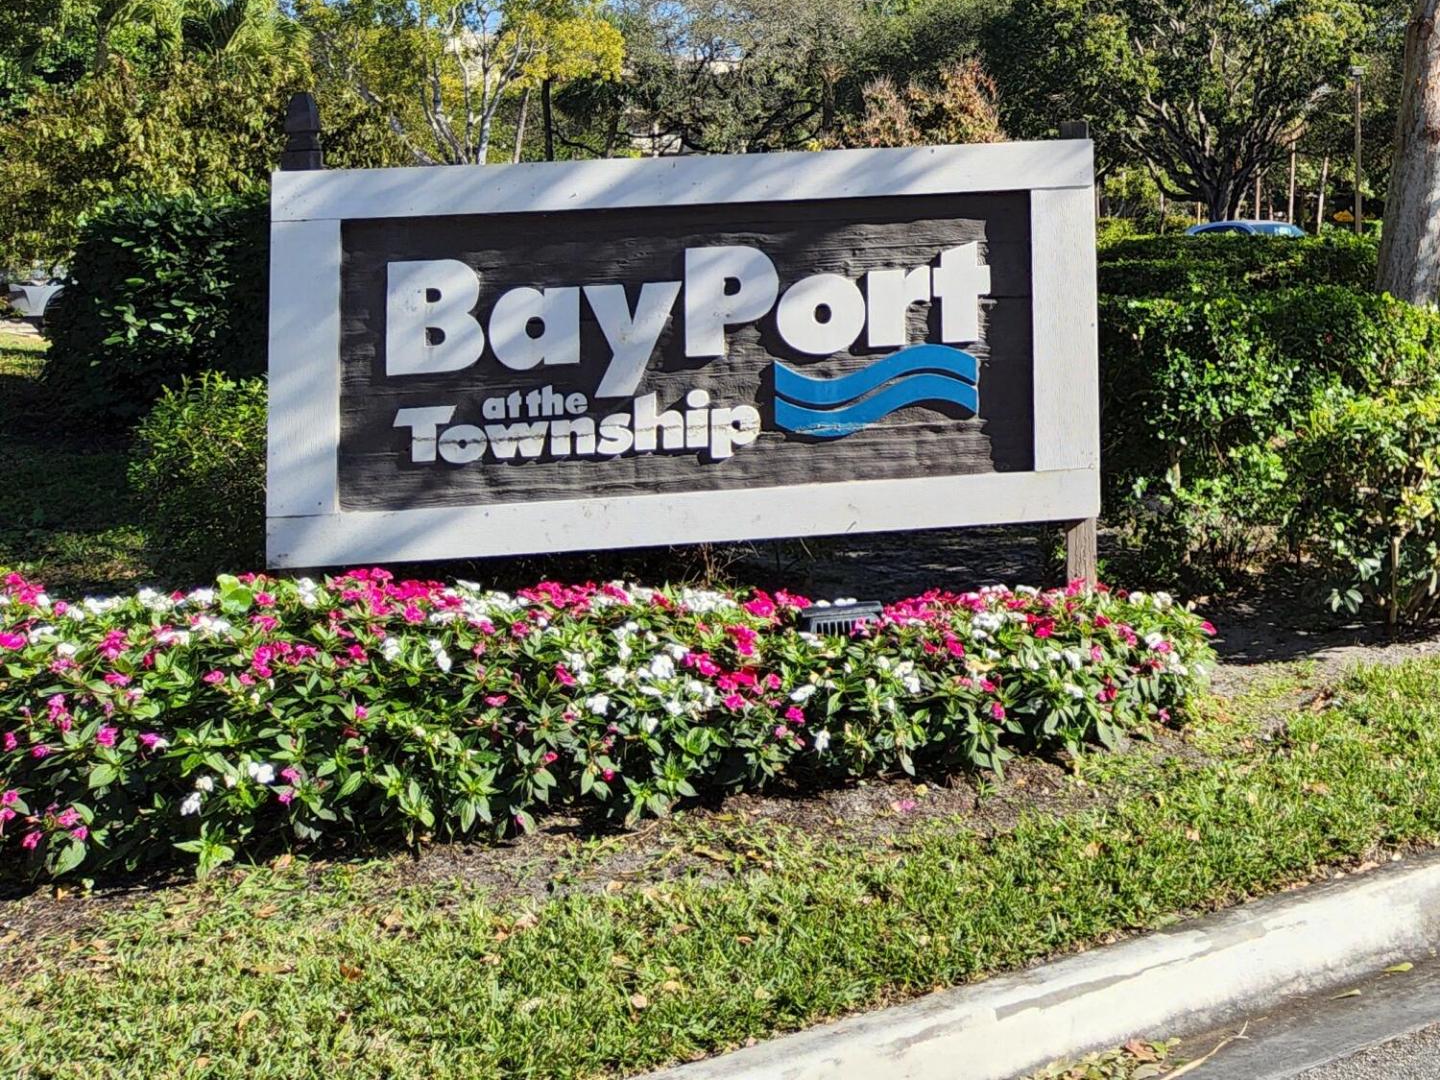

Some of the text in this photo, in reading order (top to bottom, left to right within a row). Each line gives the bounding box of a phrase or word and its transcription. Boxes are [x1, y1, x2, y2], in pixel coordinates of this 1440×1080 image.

[385, 240, 991, 398] BayPort
[394, 391, 761, 464] Township
[482, 384, 588, 420] at the
